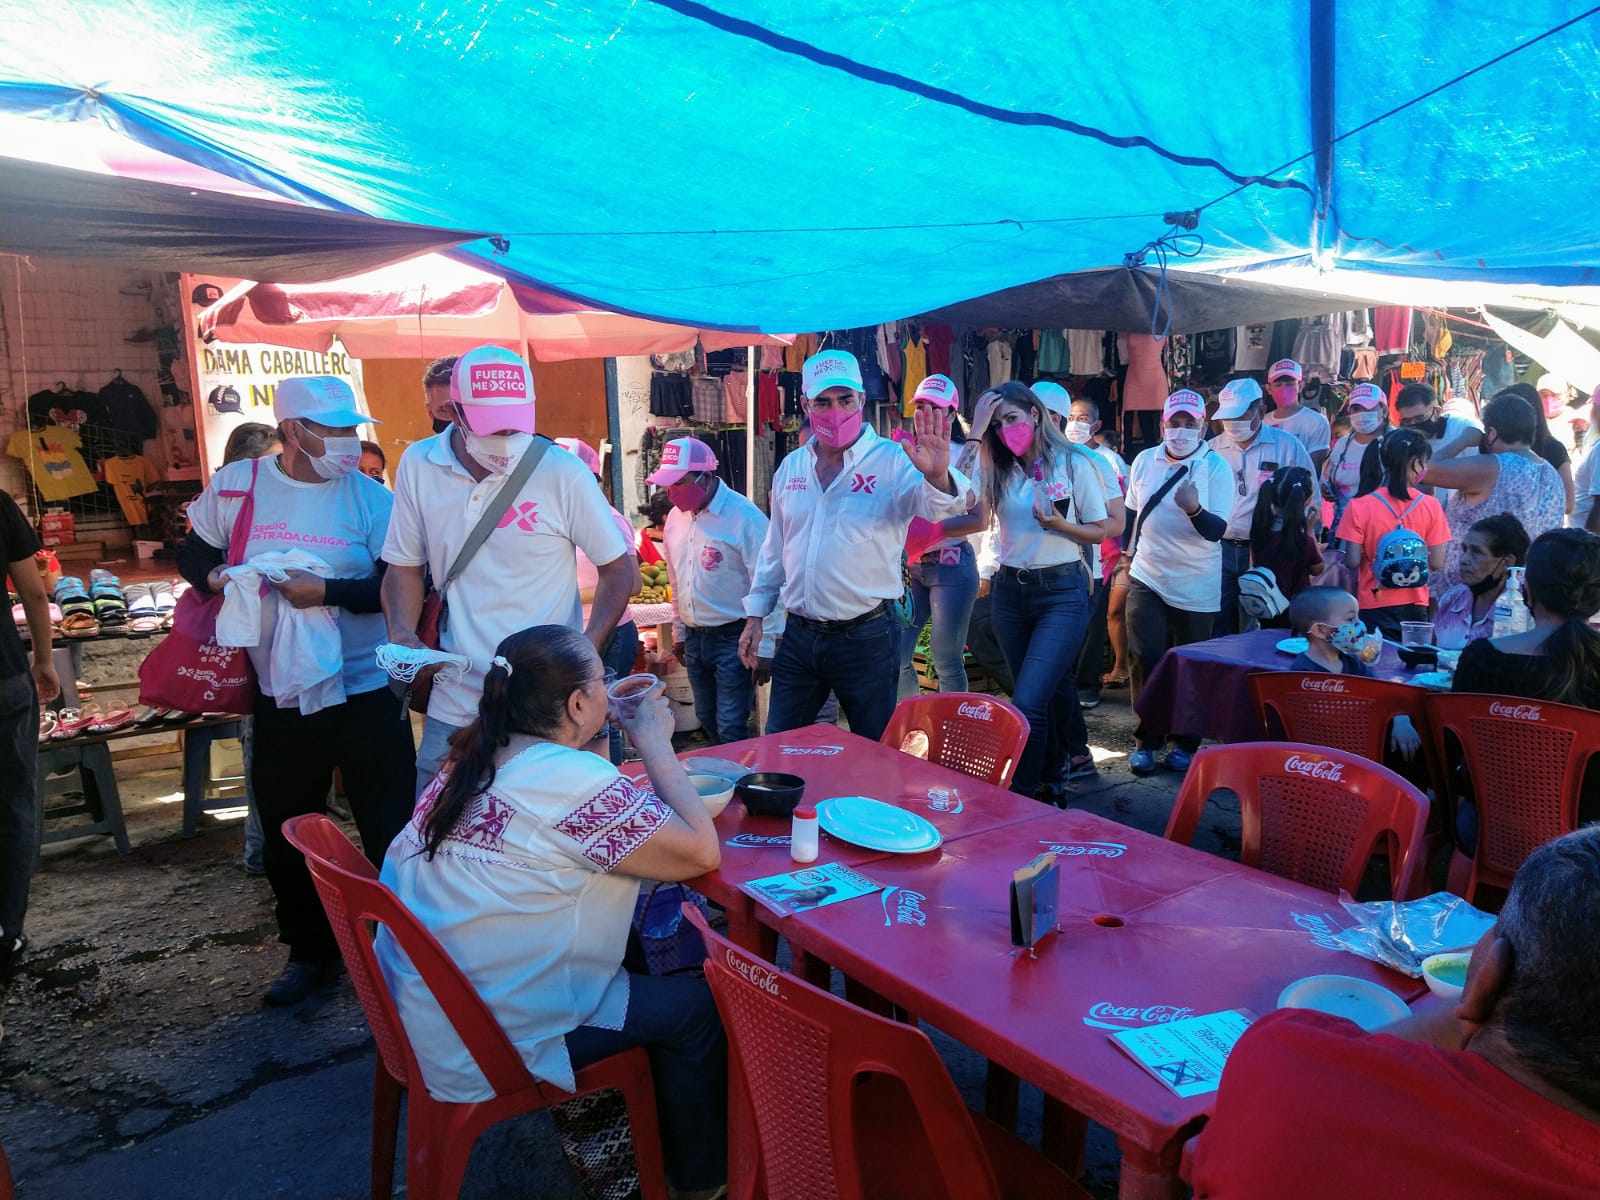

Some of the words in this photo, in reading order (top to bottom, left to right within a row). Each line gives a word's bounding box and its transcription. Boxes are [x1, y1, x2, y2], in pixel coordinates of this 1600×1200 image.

[203, 348, 253, 375] DAMA
[475, 369, 521, 380] FUERZA
[472, 379, 526, 391] MEXICO
[253, 522, 288, 533] SERGIO
[302, 533, 352, 547] CAJIGAL
[1301, 677, 1345, 693] Coca-Cola
[957, 701, 992, 721] Coca-Cola
[1489, 701, 1541, 721] Coca-Cola
[1284, 755, 1345, 782] Coca-Cola
[726, 948, 780, 996] Coca-Cola
